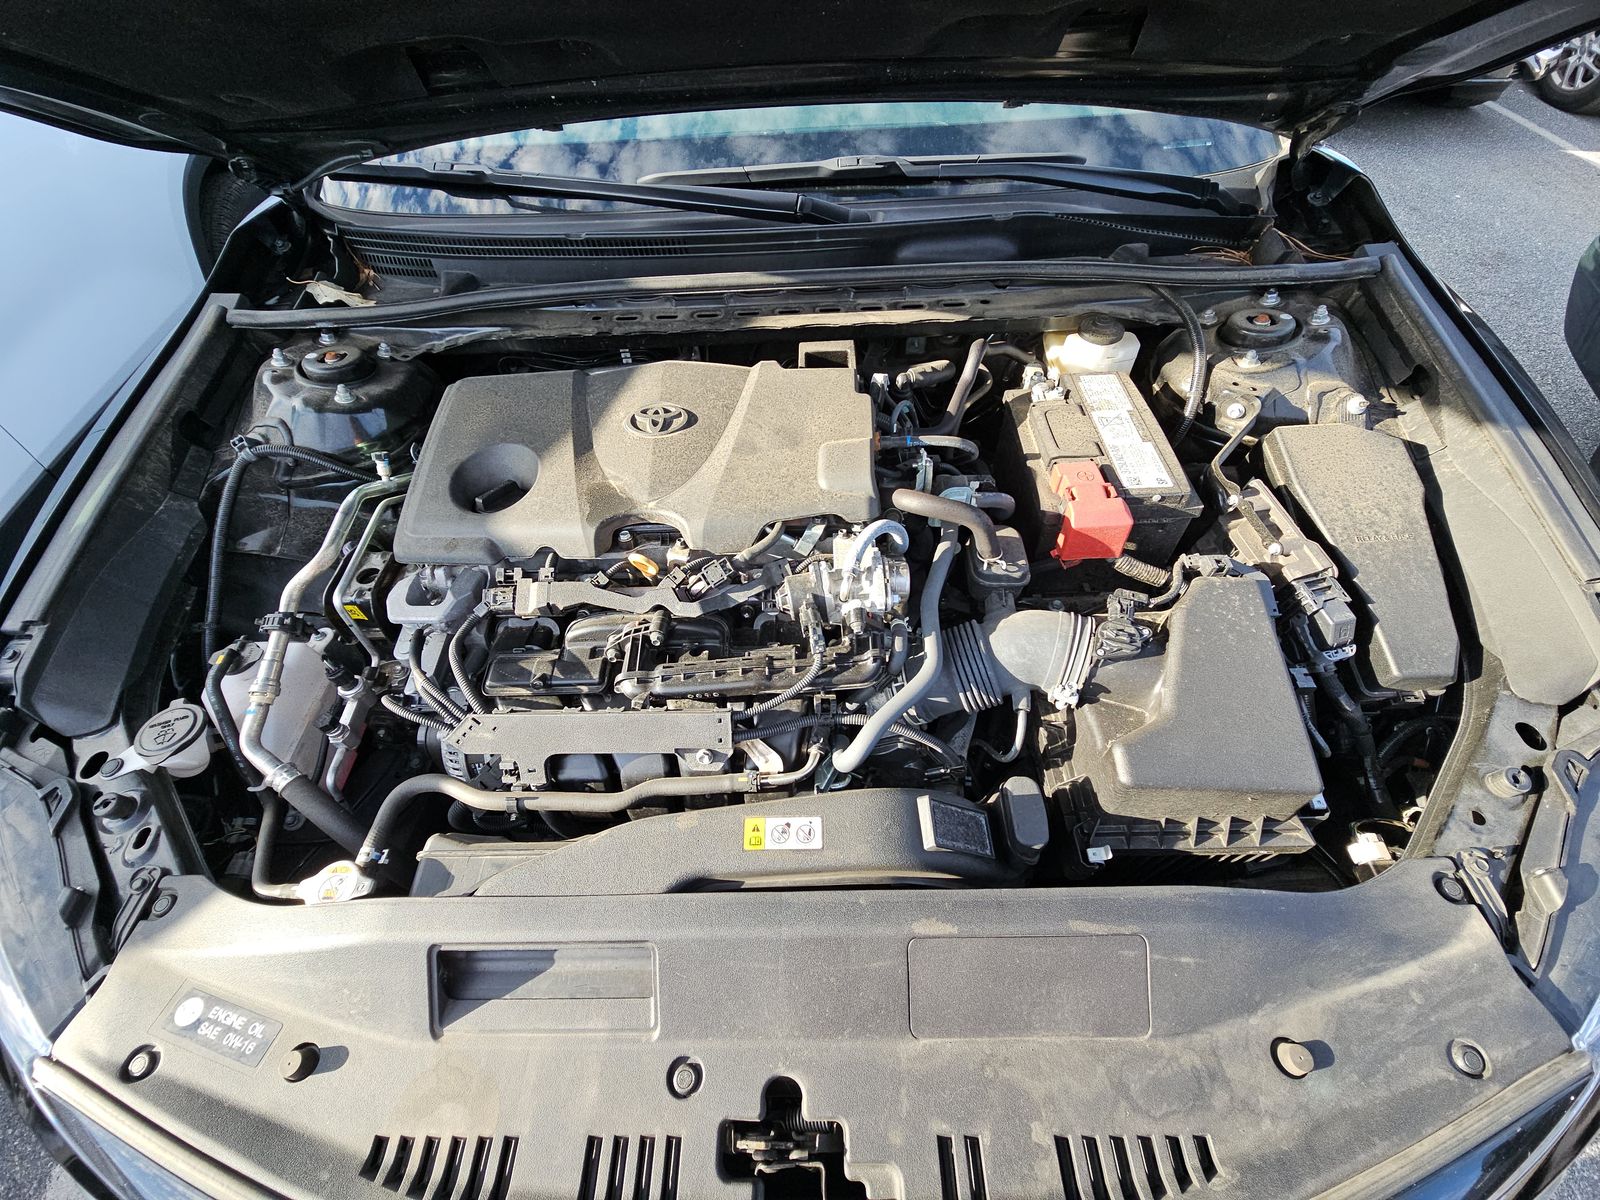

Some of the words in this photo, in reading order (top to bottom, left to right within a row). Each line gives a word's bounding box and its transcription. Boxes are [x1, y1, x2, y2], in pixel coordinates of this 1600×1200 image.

[197, 1021, 222, 1040] SAE
[208, 1006, 248, 1031] ENGINE
[247, 1021, 267, 1039] OIL
